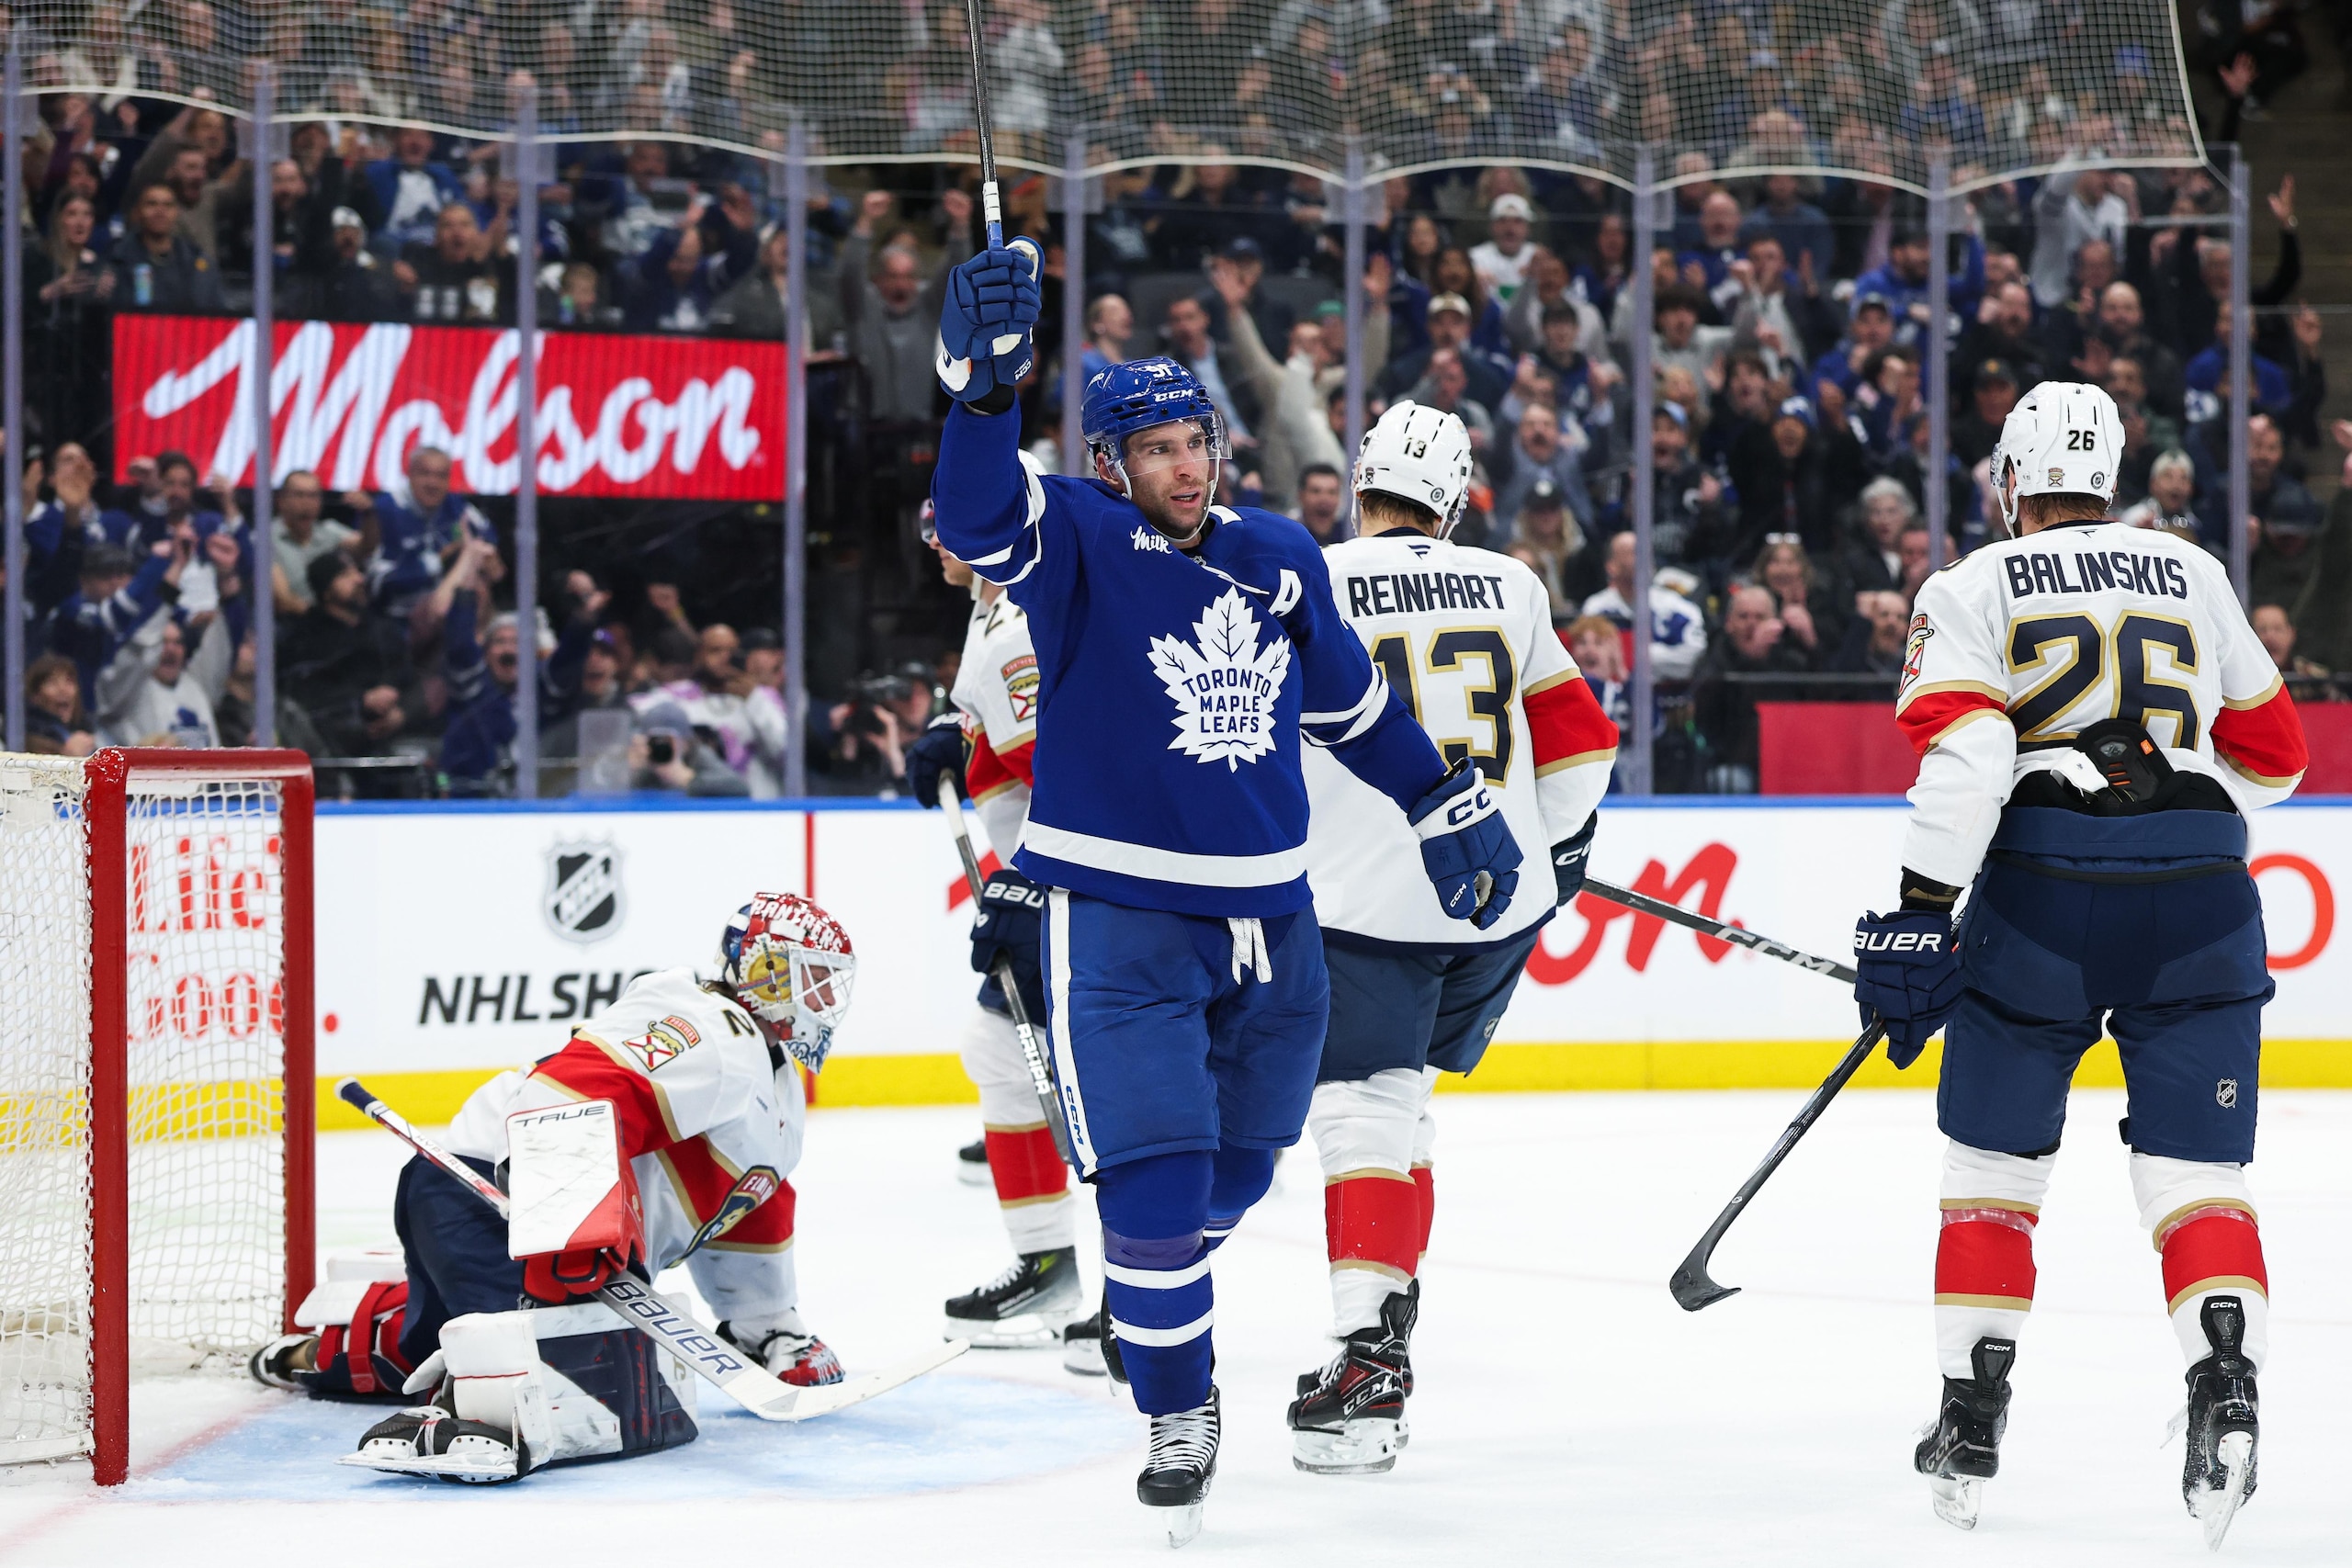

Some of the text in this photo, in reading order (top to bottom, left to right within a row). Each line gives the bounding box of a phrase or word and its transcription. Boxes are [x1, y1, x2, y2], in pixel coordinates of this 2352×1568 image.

[143, 318, 759, 493] Molson
[1154, 389, 1193, 402] CCM
[1404, 437, 1428, 459] 13
[2067, 430, 2095, 451] 26
[1130, 525, 1172, 554] Milk
[1268, 569, 1303, 617] A
[1348, 572, 1505, 618] REINHART
[2004, 551, 2188, 600] BALINSKIS
[1182, 668, 1272, 698] TORONTO
[2005, 609, 2200, 753] 26
[1200, 695, 1261, 713] MAPLE
[1200, 716, 1260, 733] LEAFS
[1369, 626, 1518, 789] 13
[1447, 787, 1493, 826] CC
[1450, 883, 1467, 908] CCM
[1714, 926, 1836, 976] CCM
[418, 970, 654, 1025] NHLSH
[514, 1105, 606, 1128] TRUE
[1066, 1085, 1084, 1145] CCM
[602, 1280, 744, 1376] BAUER
[1984, 1343, 2011, 1352] CCM
[1343, 1374, 1395, 1416] CCM
[1926, 1426, 1959, 1472] CCM
